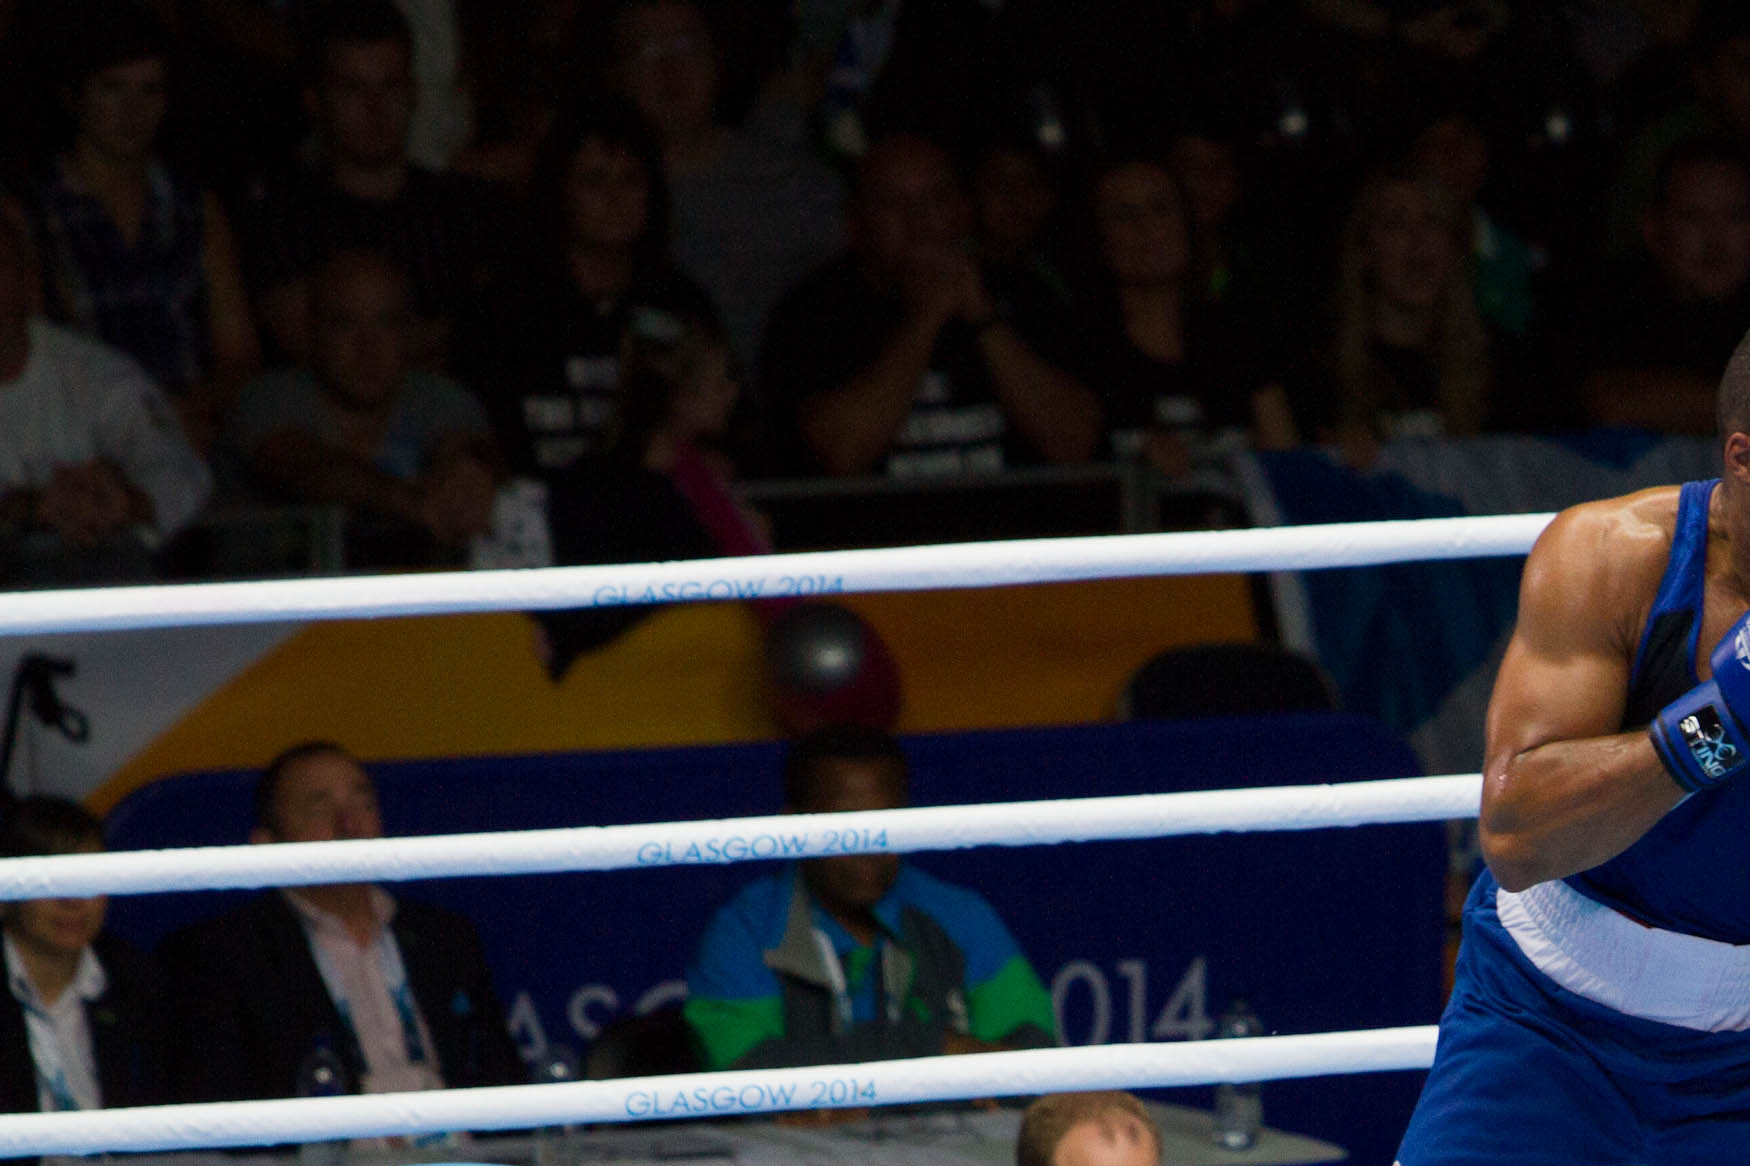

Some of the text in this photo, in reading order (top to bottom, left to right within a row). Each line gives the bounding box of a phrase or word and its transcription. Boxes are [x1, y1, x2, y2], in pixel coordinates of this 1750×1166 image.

[637, 828, 888, 865] GLASGOW 2014
[625, 1080, 876, 1116] GLASGOW 2014
